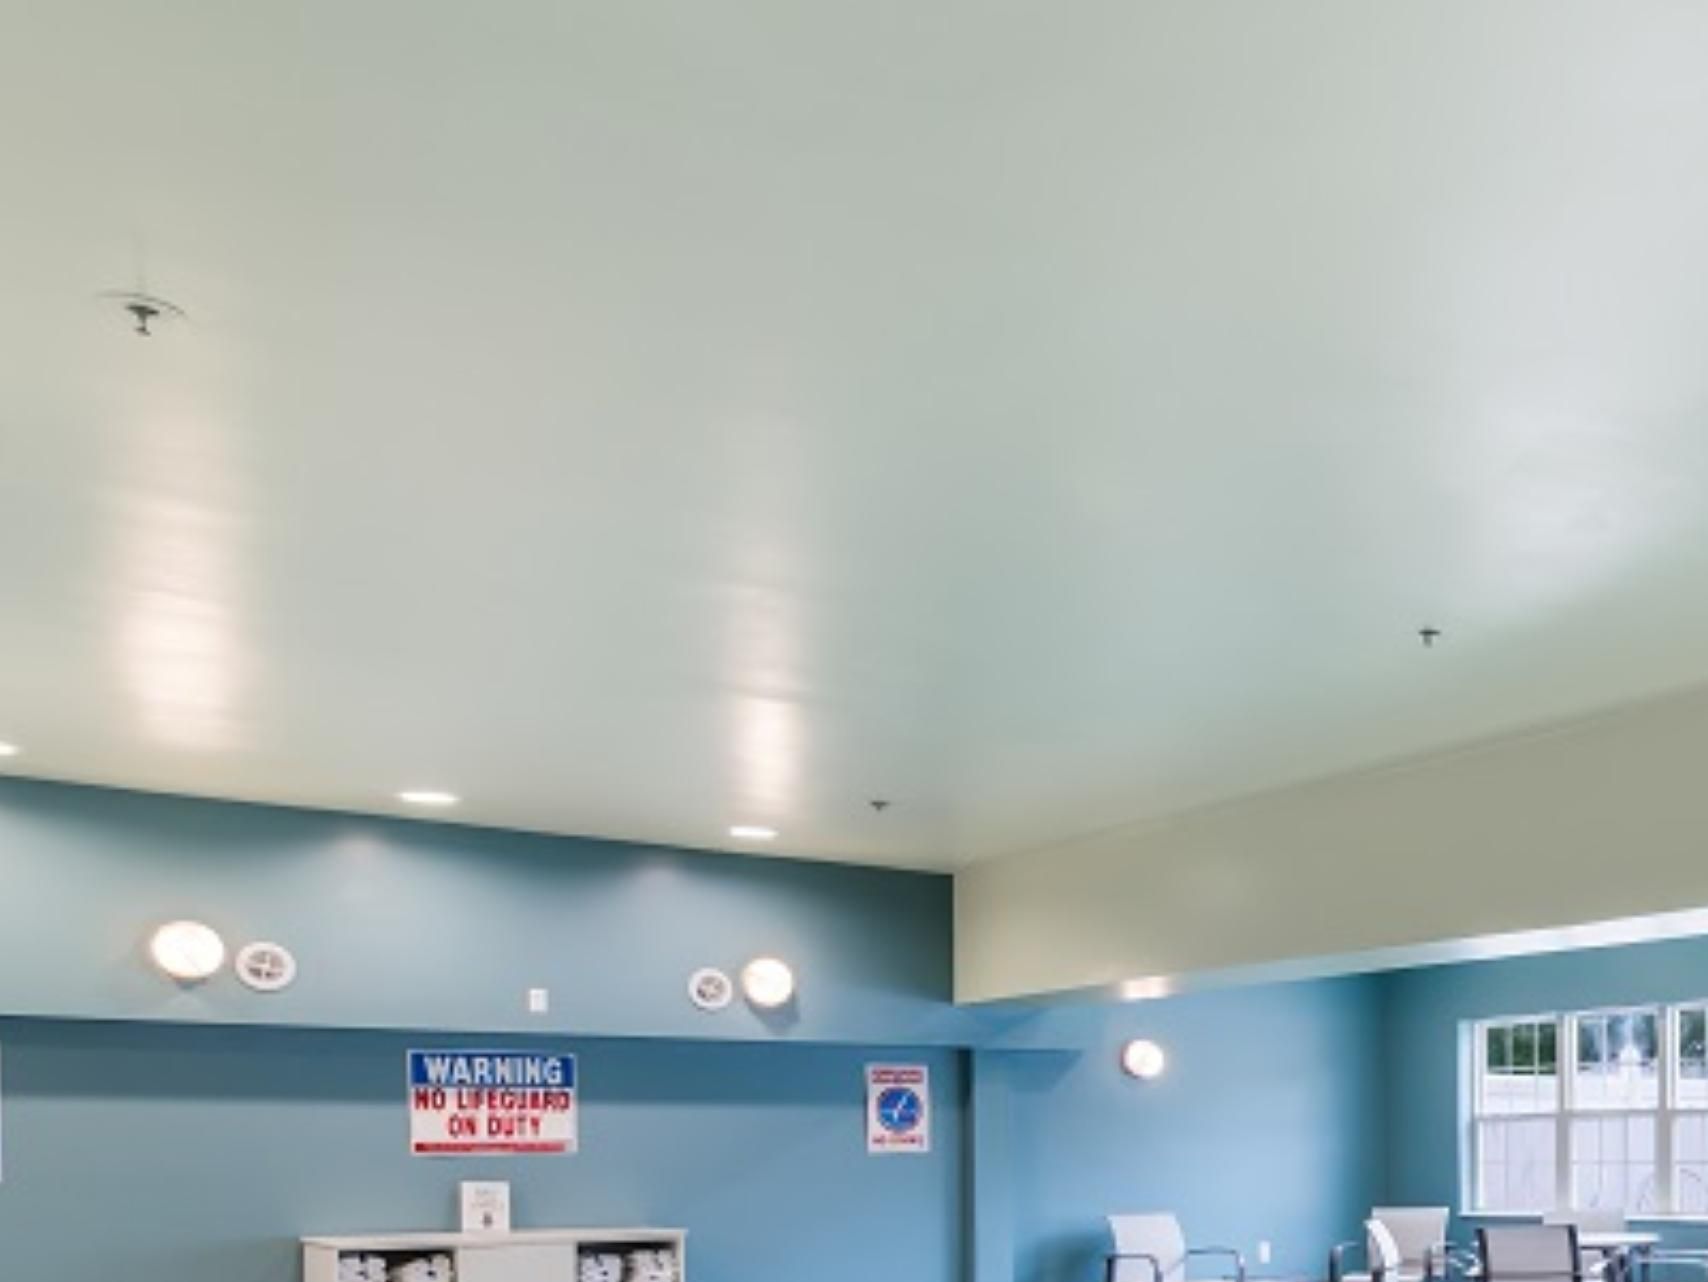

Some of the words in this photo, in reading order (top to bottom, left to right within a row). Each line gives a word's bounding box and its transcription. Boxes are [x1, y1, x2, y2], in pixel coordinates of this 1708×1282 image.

[424, 1055, 563, 1085] WARNING
[415, 1088, 446, 1110] NO
[457, 1087, 569, 1111] LIFEGUARD
[449, 1115, 476, 1136] ON
[487, 1116, 541, 1136] DUTY
